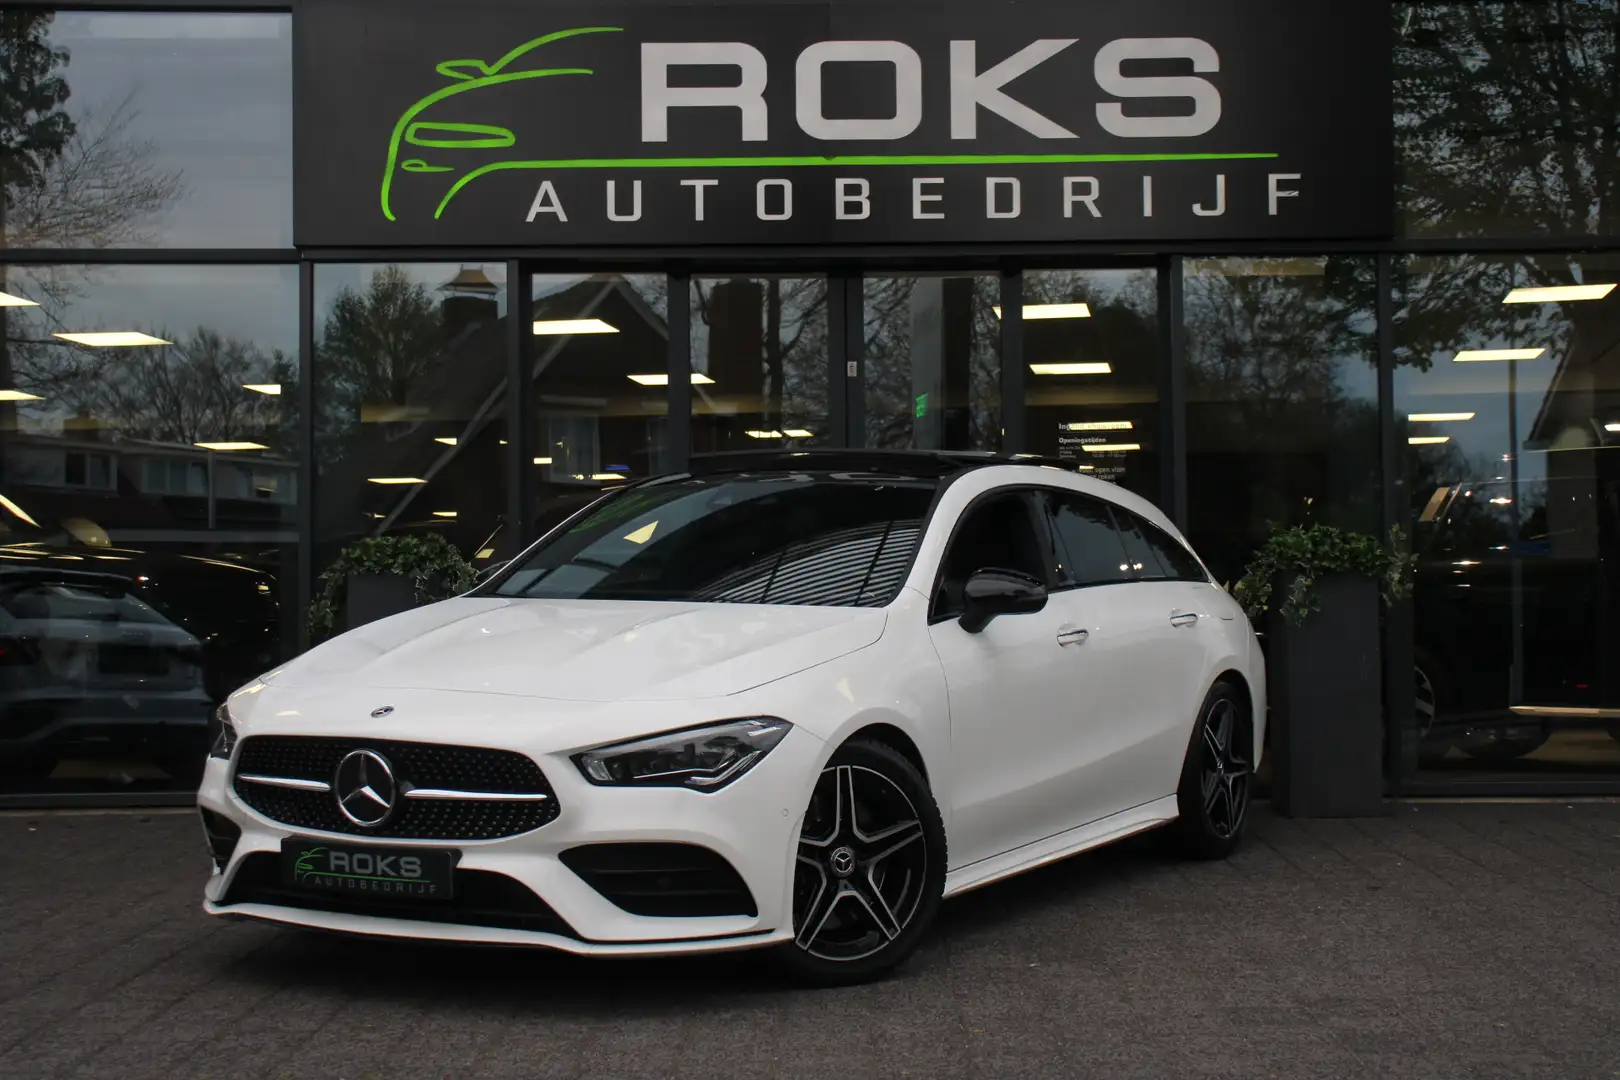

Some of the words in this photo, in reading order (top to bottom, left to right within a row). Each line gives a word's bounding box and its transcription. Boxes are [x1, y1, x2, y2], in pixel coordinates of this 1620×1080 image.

[640, 37, 1222, 143] ROKS
[525, 173, 1302, 223] AUTOBEDRIJF
[329, 851, 422, 878] ROKS
[313, 875, 438, 895] AUTOBEDRIJF
